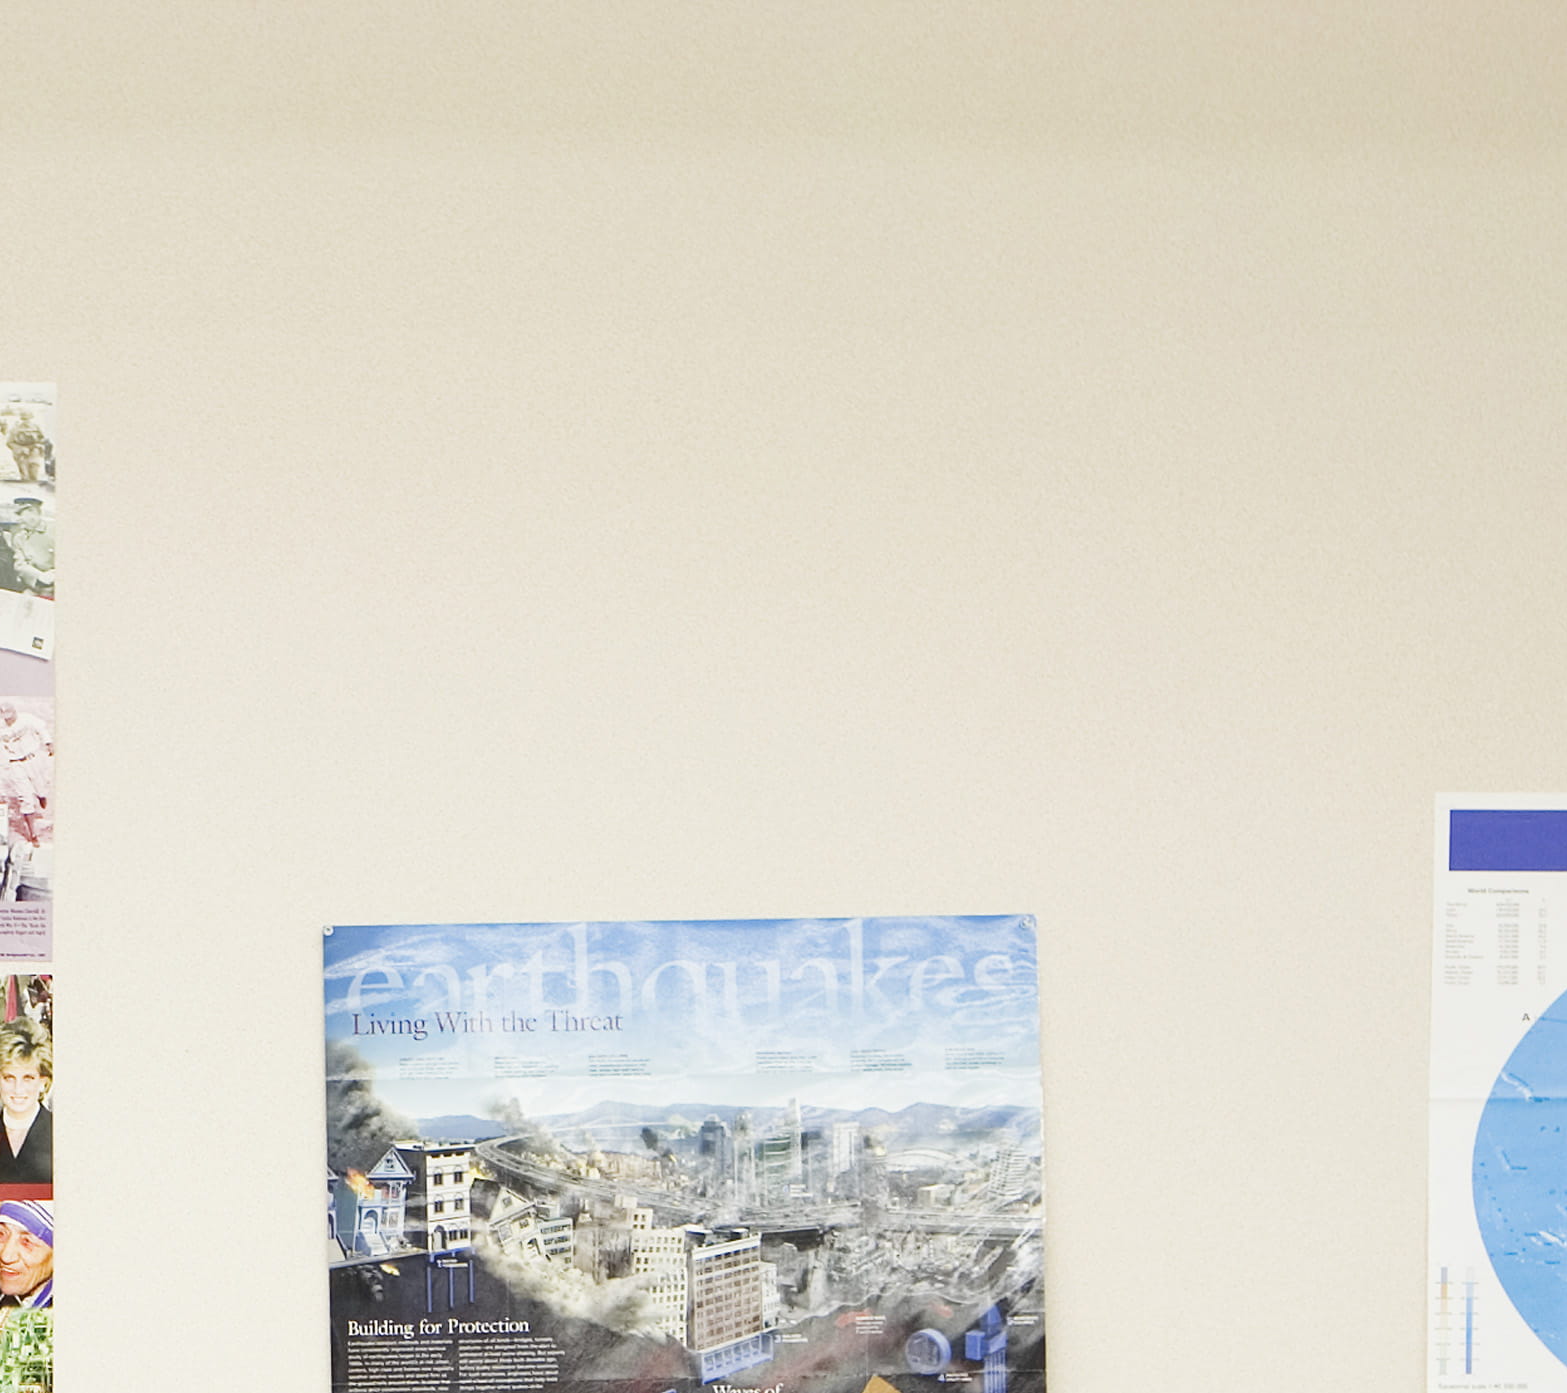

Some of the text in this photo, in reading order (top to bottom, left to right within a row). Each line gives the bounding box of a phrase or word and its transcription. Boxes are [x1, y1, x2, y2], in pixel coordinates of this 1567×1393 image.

[347, 922, 1015, 1019] earthquakes
[352, 1010, 623, 1041] Living With the Threat
[348, 1318, 530, 1336] Building for Protection
